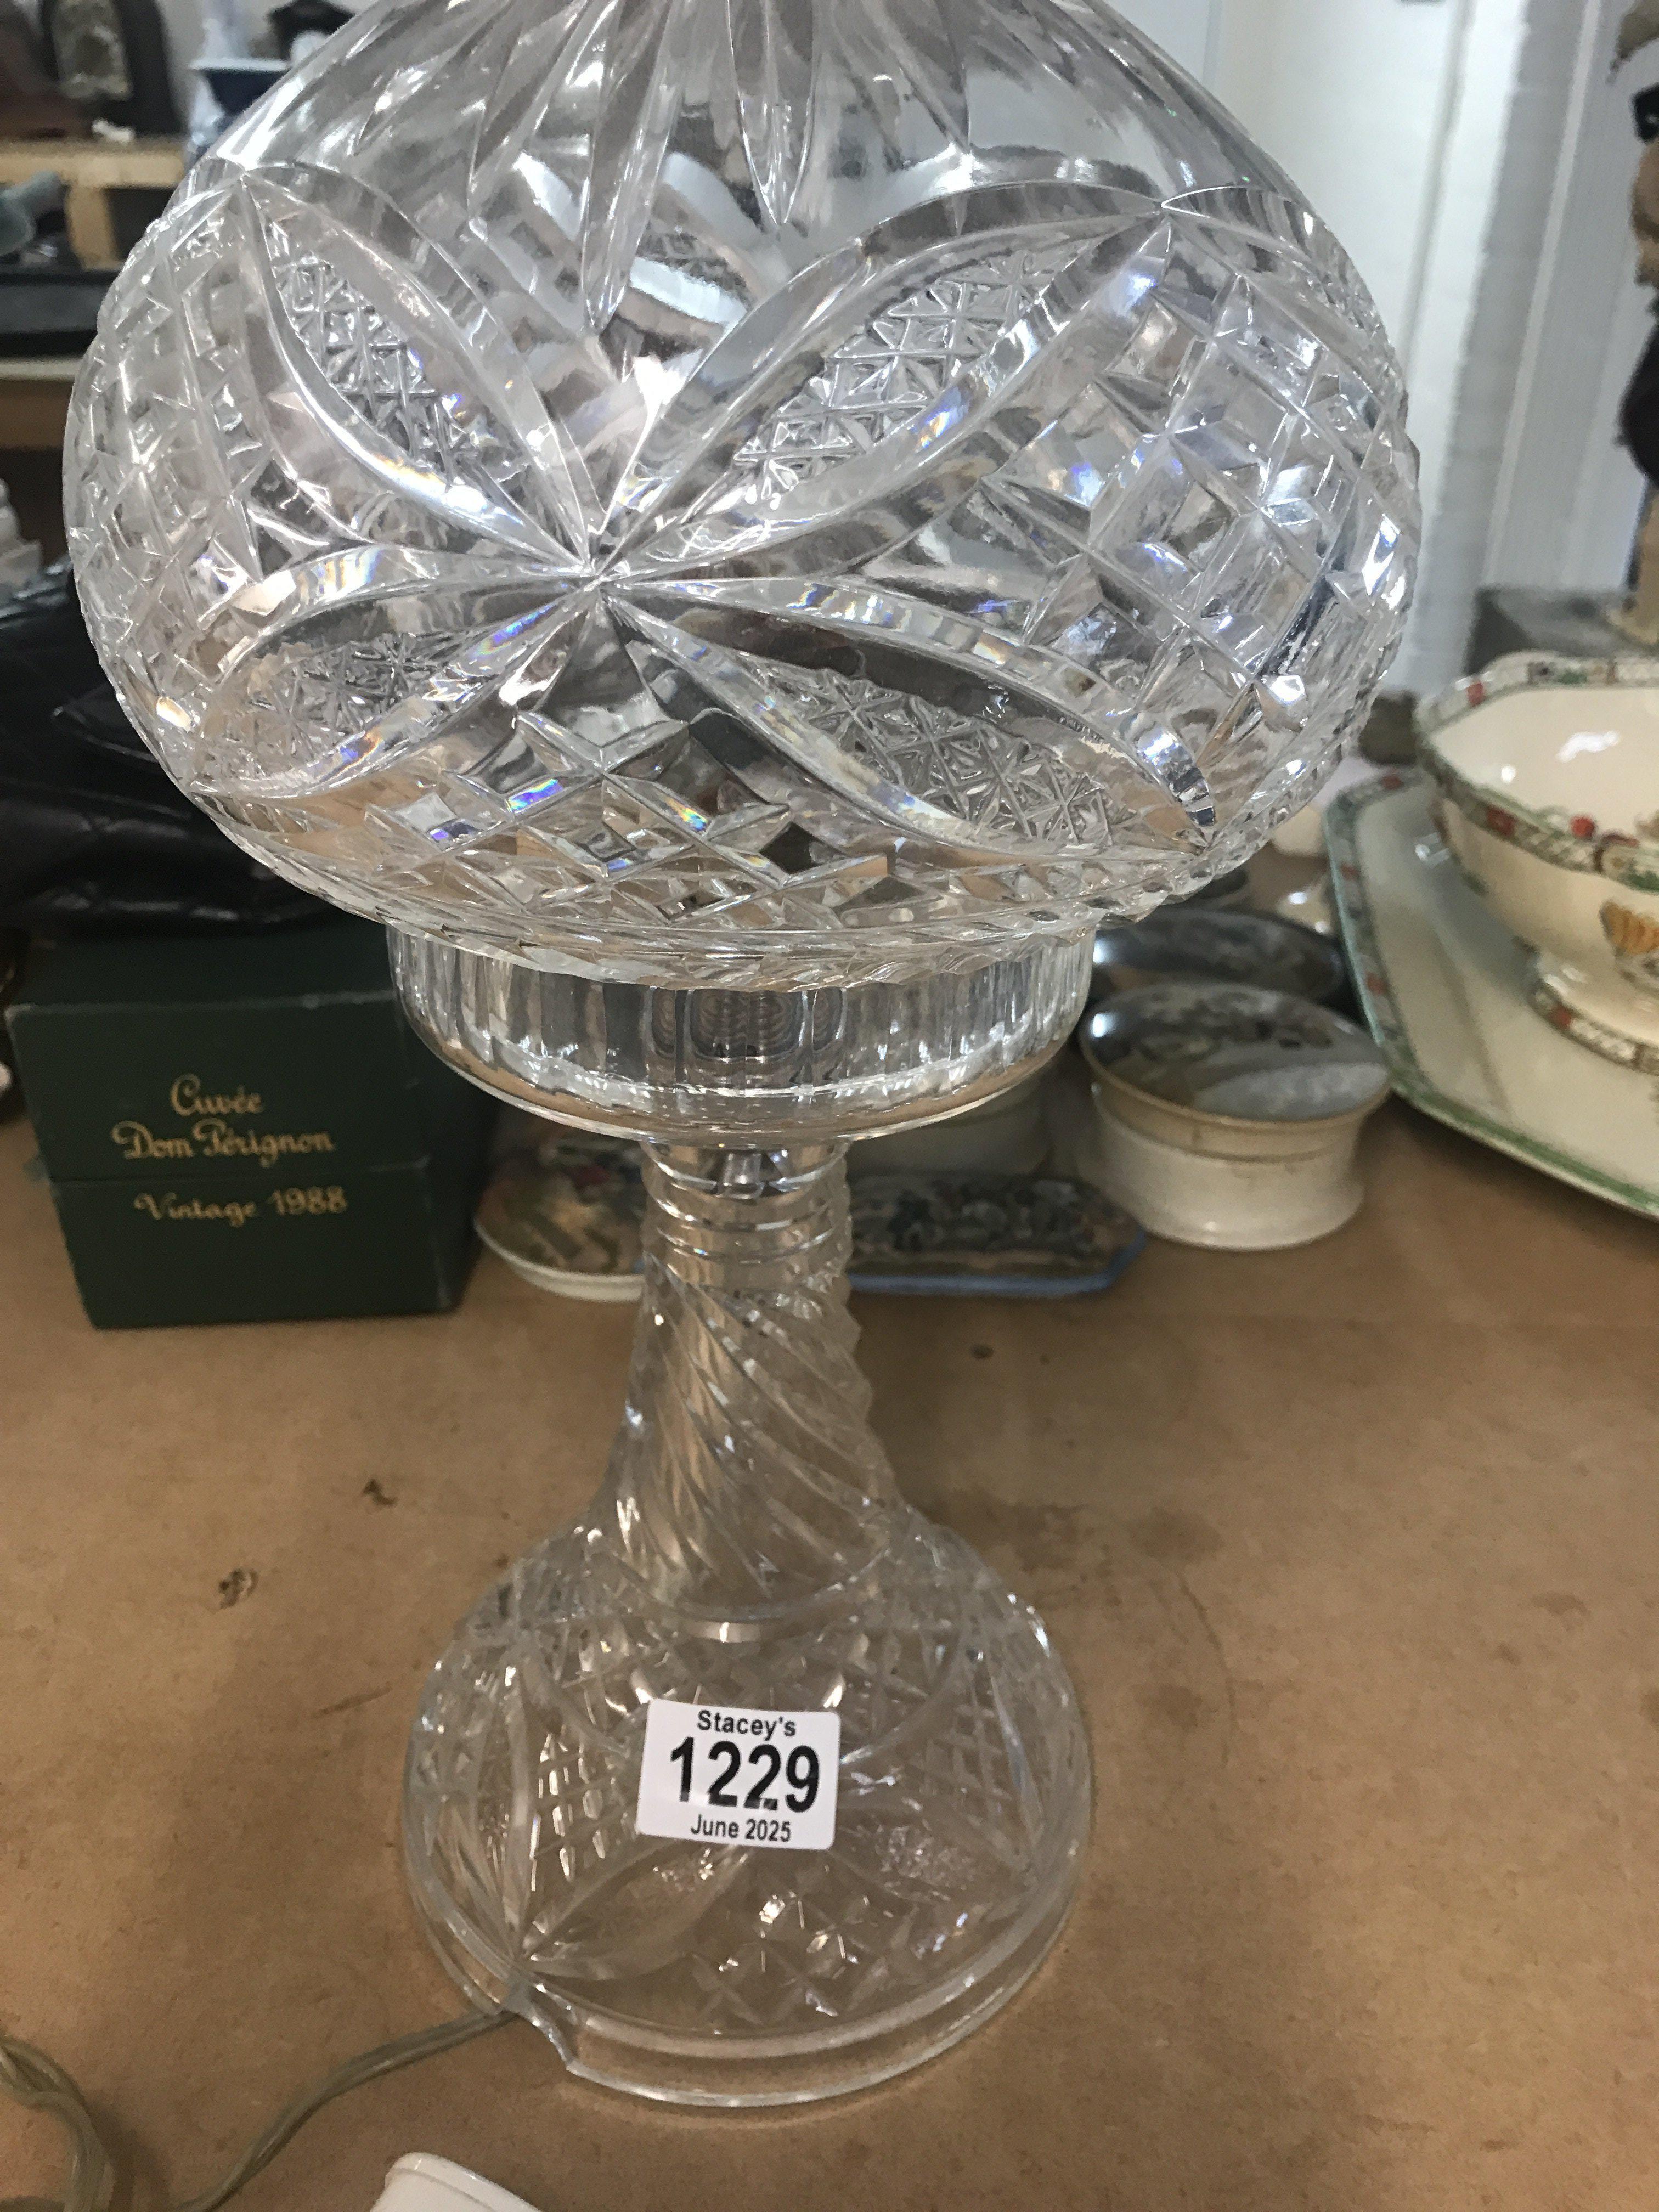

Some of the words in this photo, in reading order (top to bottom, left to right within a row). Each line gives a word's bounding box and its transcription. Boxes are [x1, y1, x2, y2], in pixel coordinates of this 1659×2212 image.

[112, 1120, 194, 1159] Dom
[133, 1193, 258, 1227] Vintage
[268, 1186, 347, 1215] 1988
[697, 1709, 796, 1741] Stacey's
[670, 1736, 820, 1813] 1229
[690, 1813, 740, 1839] June
[744, 1818, 792, 1842] 2025
